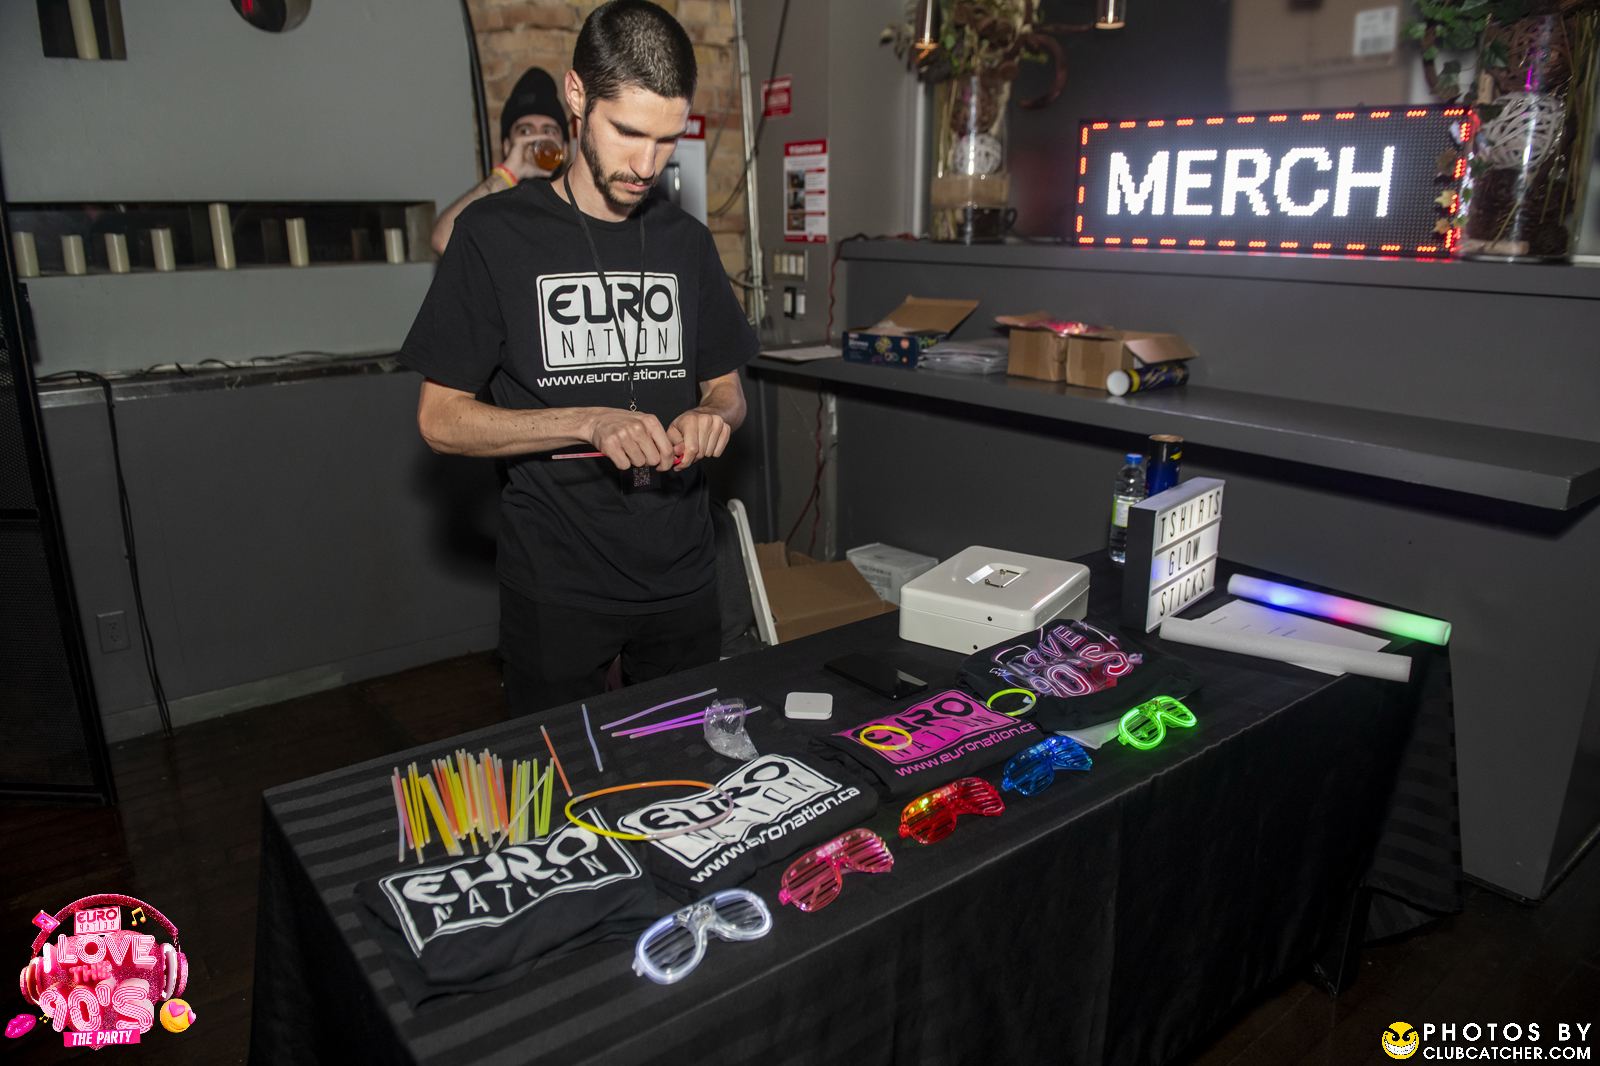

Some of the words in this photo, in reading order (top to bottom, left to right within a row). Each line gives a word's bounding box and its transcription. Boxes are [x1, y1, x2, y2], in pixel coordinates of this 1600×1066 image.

[1106, 146, 1396, 217] MERCH
[547, 282, 674, 326] EURO
[1160, 490, 1222, 544] TSHIRTS
[1168, 536, 1200, 577] GLOW
[1159, 568, 1206, 617] STICKS
[851, 697, 974, 744] EURO
[895, 722, 1037, 777] www.euronation.ca
[639, 761, 790, 830] EURO
[402, 827, 616, 904] EURO
[432, 854, 608, 929] NATION
